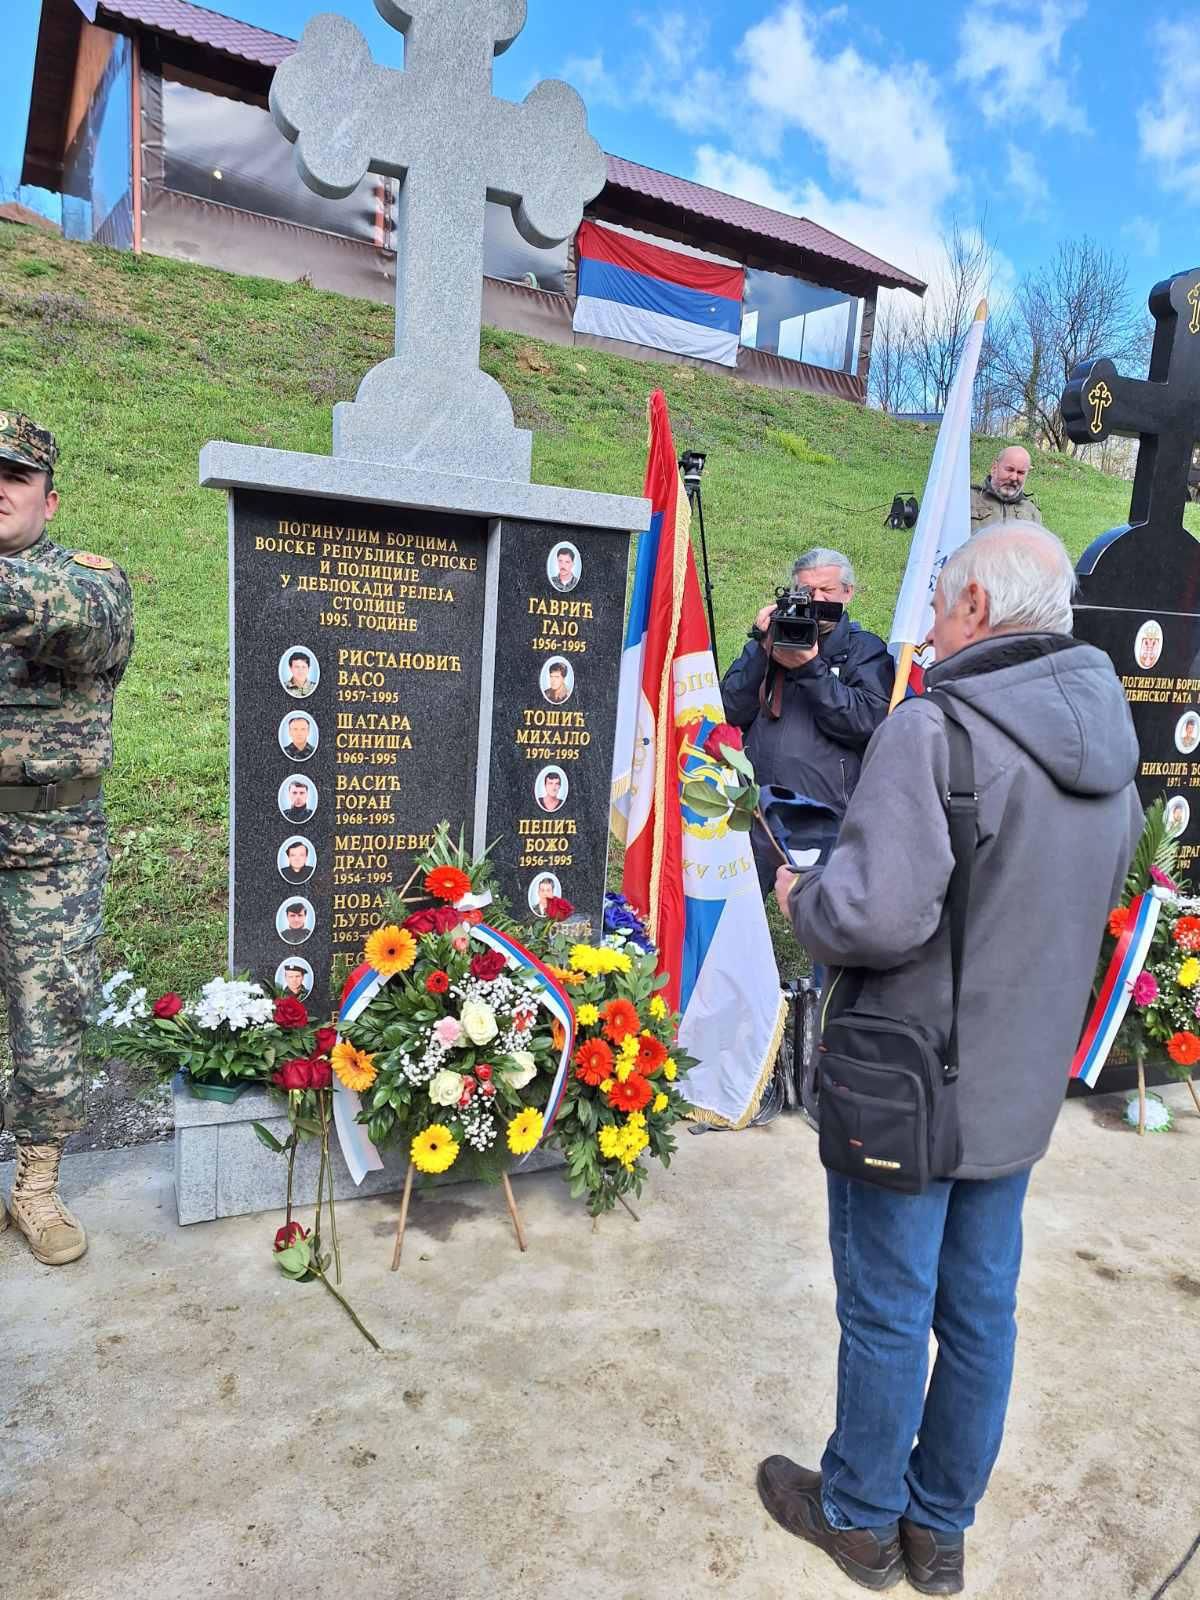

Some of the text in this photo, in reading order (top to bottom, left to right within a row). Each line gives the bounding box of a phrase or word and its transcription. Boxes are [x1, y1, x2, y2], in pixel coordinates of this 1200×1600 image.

[278, 520, 458, 553] ПОГИНУЛИМ БОРЦИМА
[255, 536, 478, 571] ВОЈСКЕ РЕПУБЛИКЕ СРПСКЕ
[320, 561, 420, 583] И ПОЛИЦИЈЕ
[280, 574, 455, 602] У ДЕБЛОКАДИ РЕЛЕЈА
[332, 597, 406, 615] СТОЛИЦЕ
[528, 597, 594, 619] ГАВРИЋ
[320, 612, 418, 632] 1995. ГОДИНЕ
[541, 619, 579, 637] ГАЈО
[532, 638, 586, 653] 1956-1995
[338, 649, 462, 672] РИСТАНОВИЋ
[337, 671, 385, 687] ВАСО
[1122, 675, 1175, 690] ПОГИНУЛИМ
[338, 690, 399, 704] 1957-1995
[1172, 691, 1192, 703] РАТА
[336, 713, 412, 731] ШАТАРА
[523, 709, 585, 727] ТОШИЋ
[336, 734, 413, 750] СИНИША
[515, 729, 591, 746] МИХАЈЛО
[336, 752, 397, 765] 1969-1995
[526, 748, 580, 760] 1970-1995
[1141, 762, 1188, 775] НИКОЛИЋ
[336, 775, 401, 791] ВАСИЋ
[335, 795, 392, 810] ГОРАН
[335, 813, 395, 825] 1968-1995
[525, 838, 569, 852] БОЖО
[1178, 845, 1200, 859] ДРАГ
[333, 855, 388, 872] ДРАГО
[519, 855, 573, 867] 1956-1995
[334, 872, 393, 885] 1954-1995
[333, 893, 390, 910] НОВА
[332, 912, 382, 928] ЉУБО
[332, 931, 369, 943] 1963-
